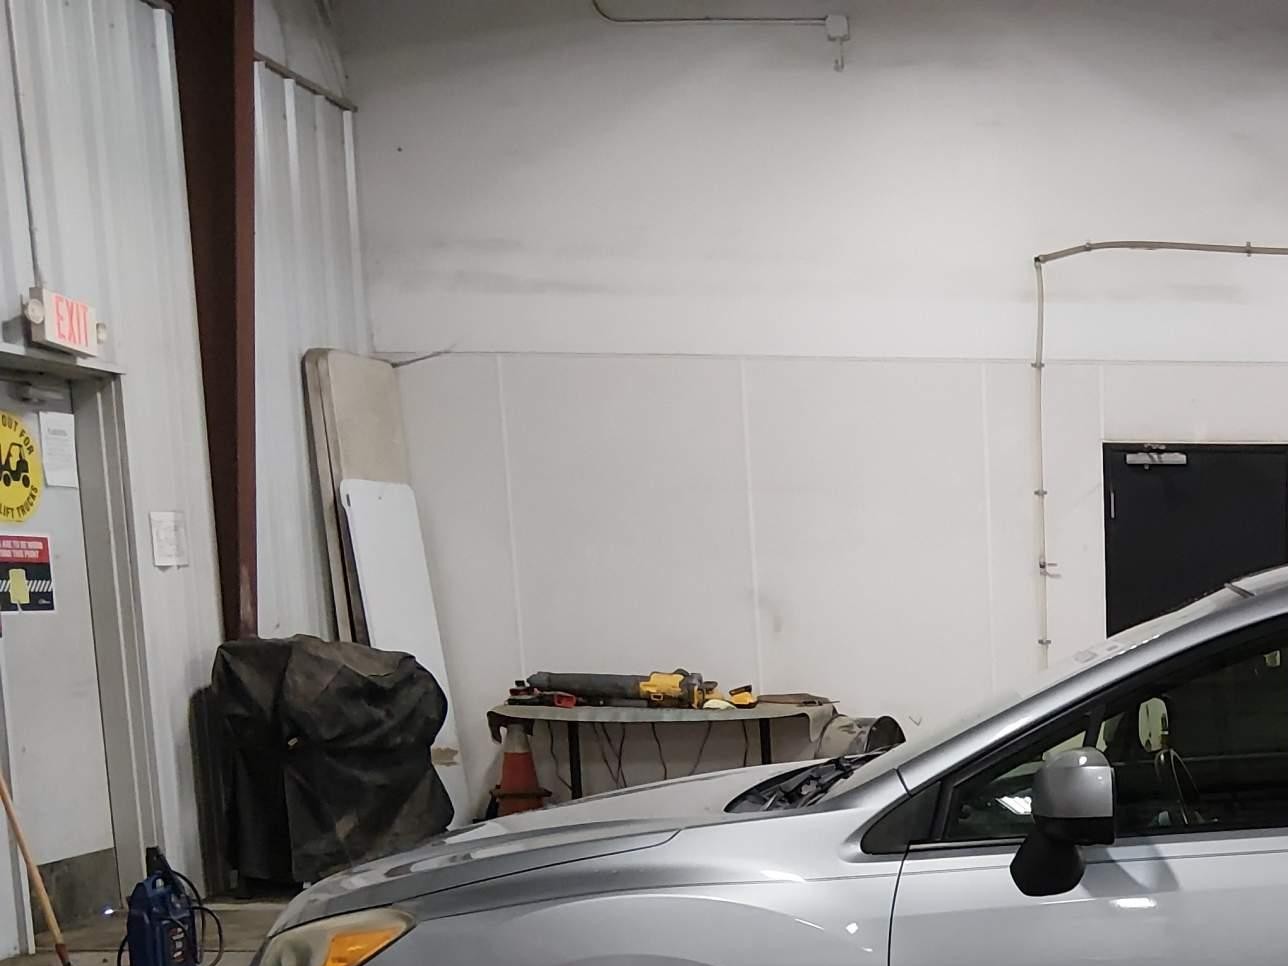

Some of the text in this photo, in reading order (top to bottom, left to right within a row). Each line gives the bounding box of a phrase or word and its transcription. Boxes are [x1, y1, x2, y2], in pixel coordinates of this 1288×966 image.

[53, 294, 89, 347] EXIT
[2, 414, 34, 455] OUT FOR
[16, 485, 38, 517] TRUCKS
